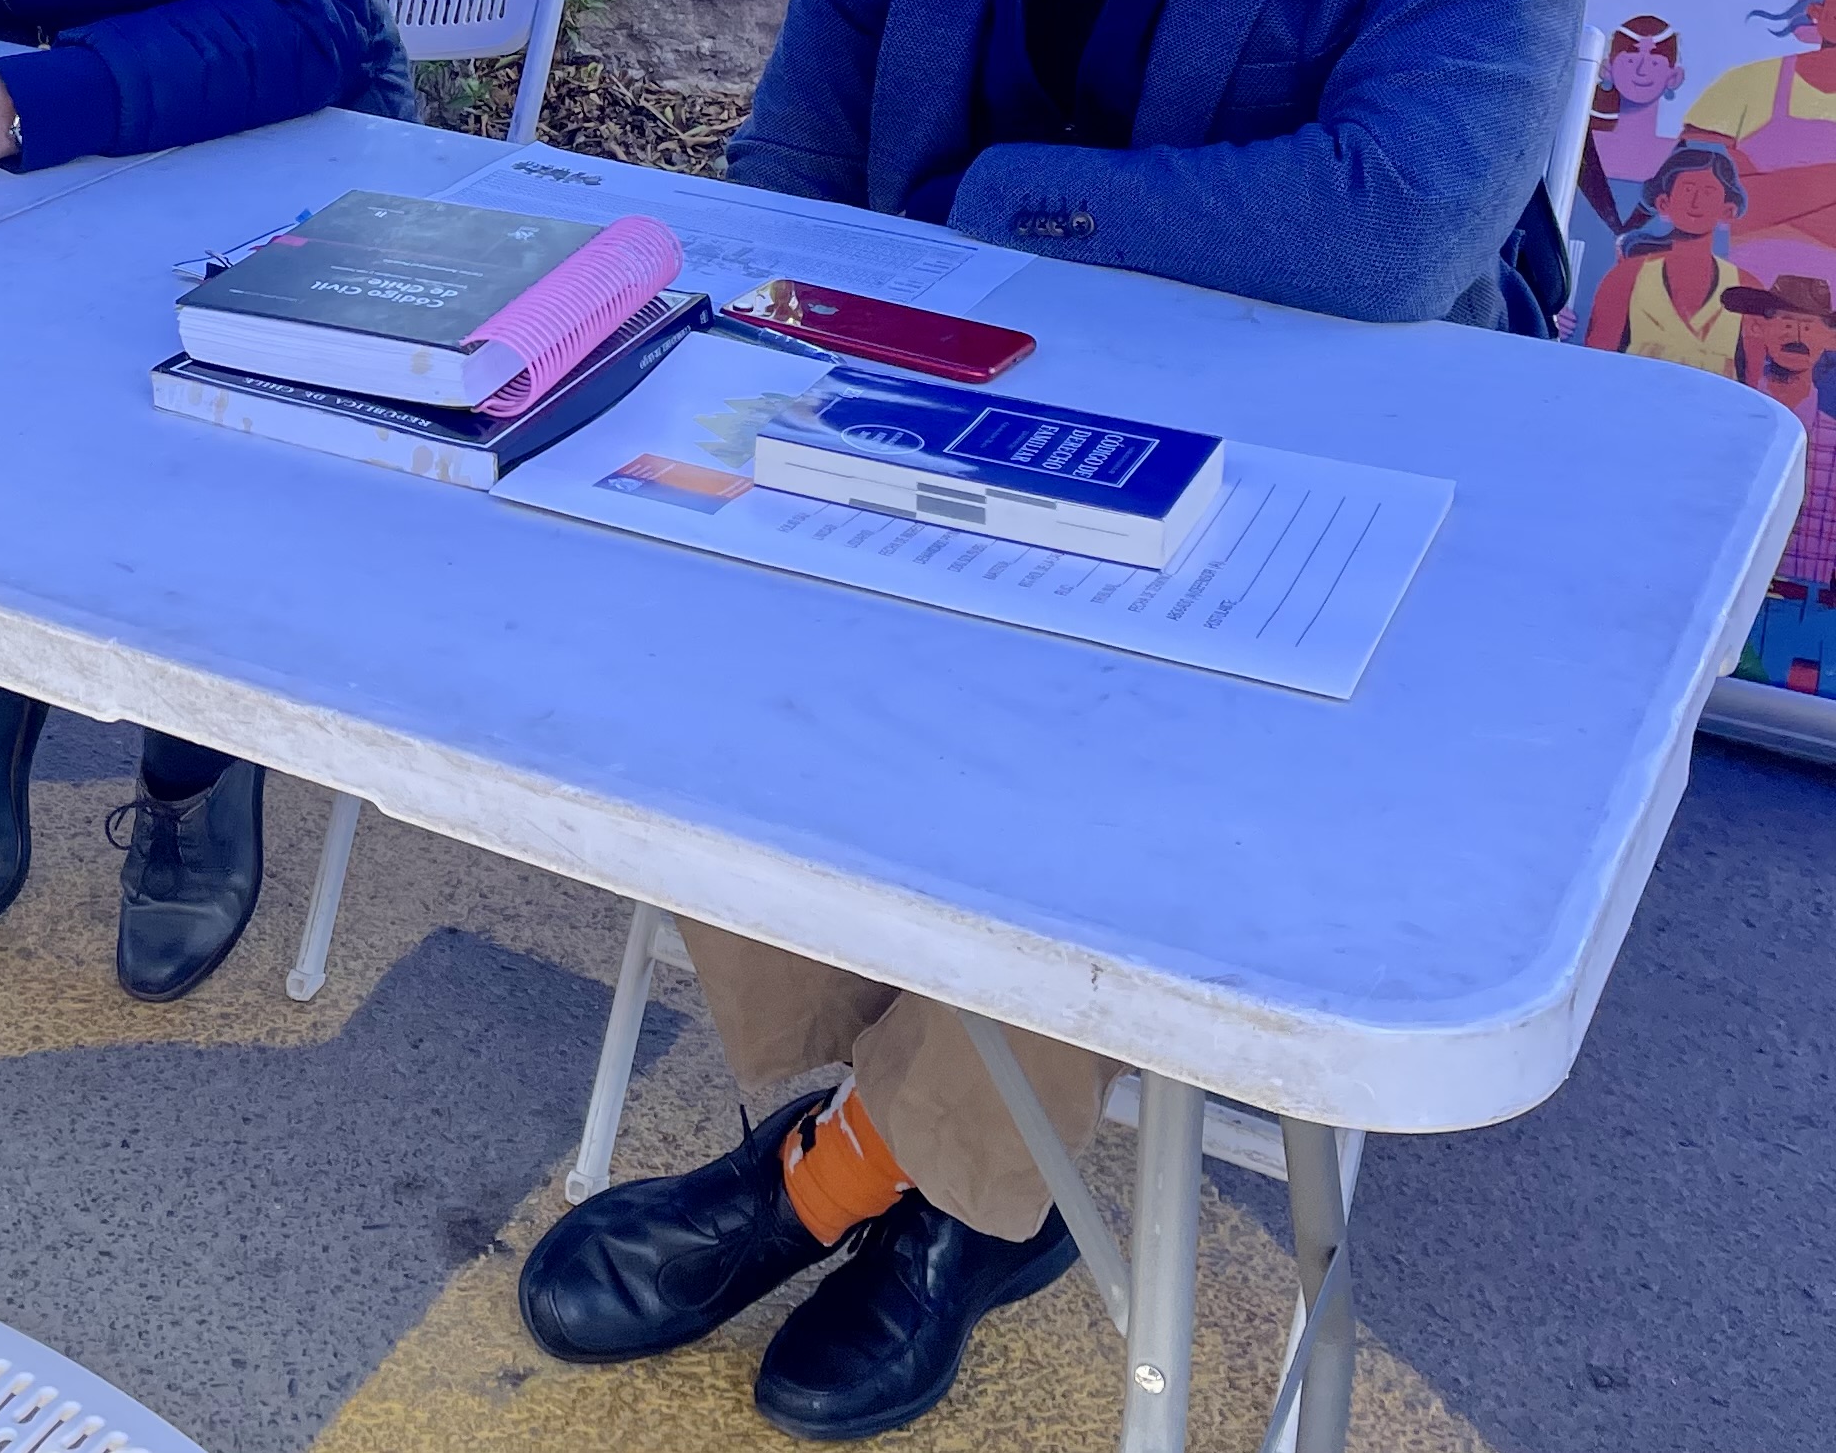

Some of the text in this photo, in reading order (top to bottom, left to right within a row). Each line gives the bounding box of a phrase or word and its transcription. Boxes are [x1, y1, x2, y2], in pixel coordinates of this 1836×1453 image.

[311, 280, 444, 308] Código Civil
[367, 278, 458, 298] de Chile
[1010, 424, 1060, 463] FAMILIAR
[1042, 429, 1092, 471] DERECHO
